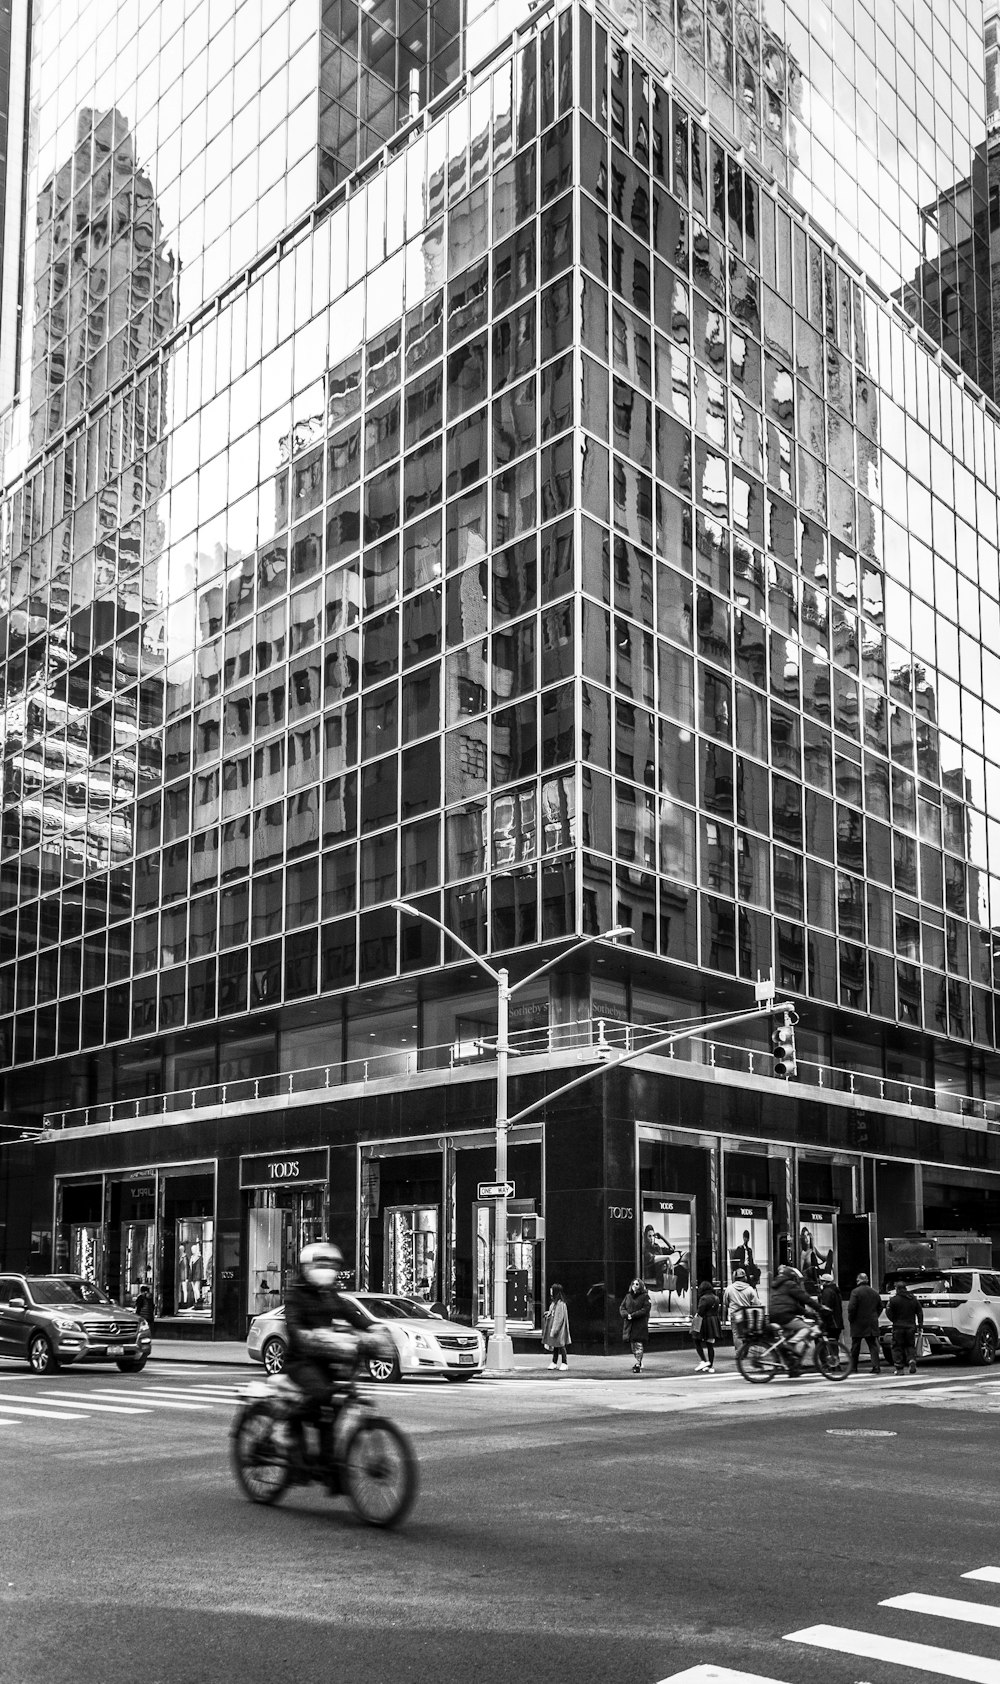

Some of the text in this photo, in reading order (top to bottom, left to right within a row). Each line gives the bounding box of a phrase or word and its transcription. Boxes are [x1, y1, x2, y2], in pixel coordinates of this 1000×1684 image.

[268, 1160, 299, 1178] TOD'S
[481, 1186, 510, 1195] ONE WAY
[608, 1206, 633, 1219] TOD'S
